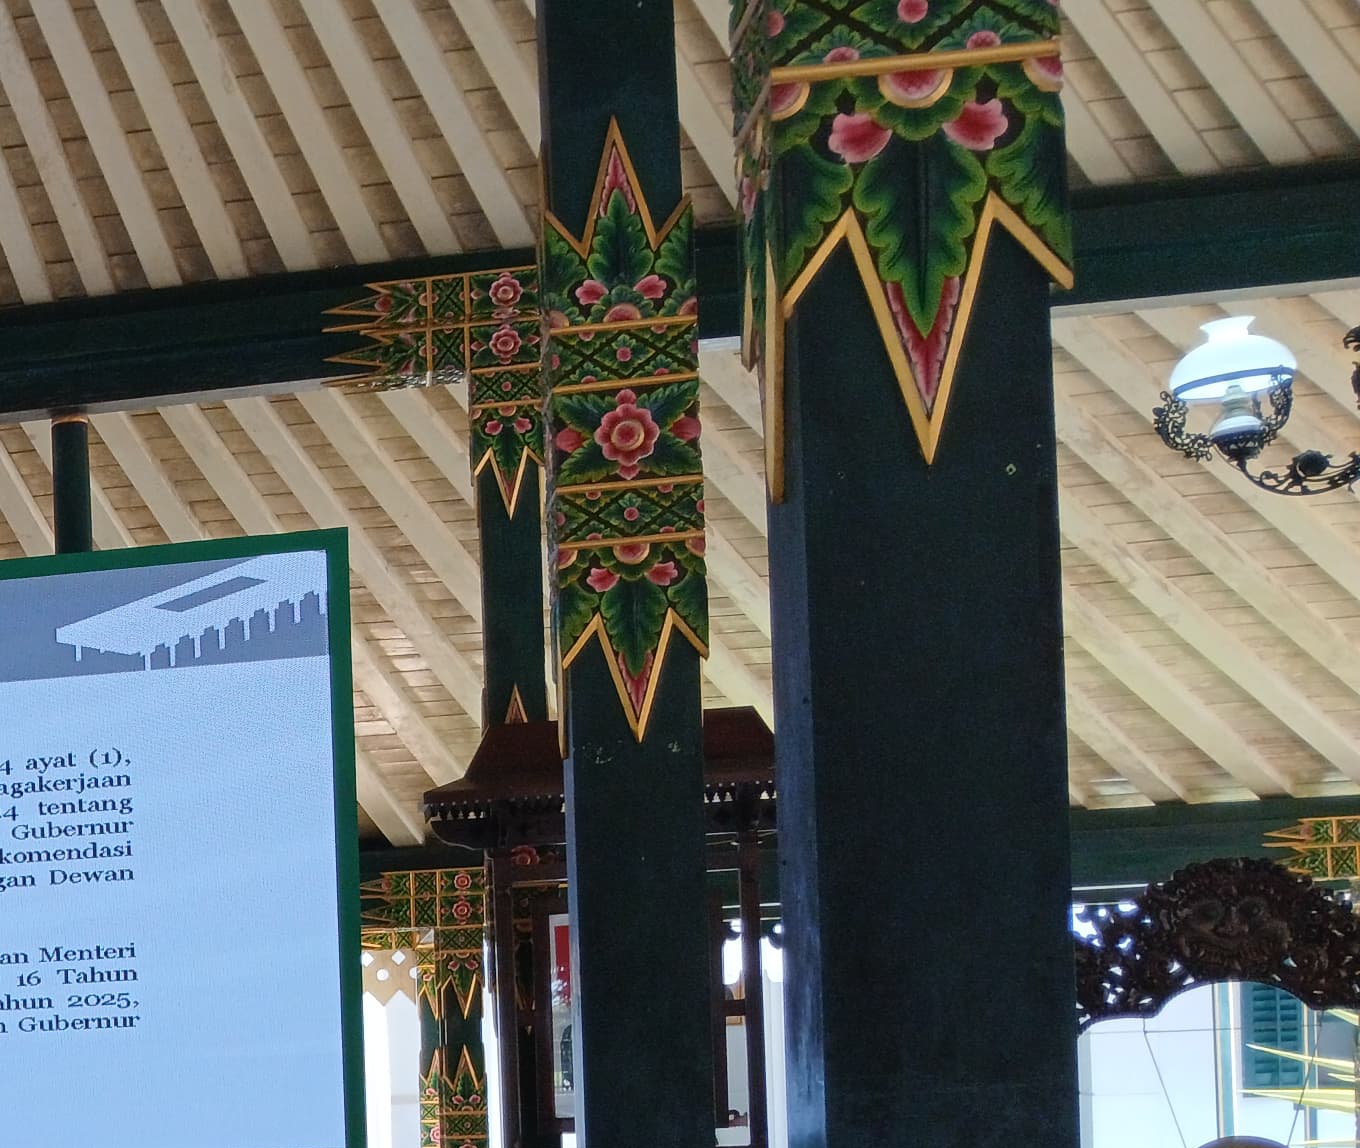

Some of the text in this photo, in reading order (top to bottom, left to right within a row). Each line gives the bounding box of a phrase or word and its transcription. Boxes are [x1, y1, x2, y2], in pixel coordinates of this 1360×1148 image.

[25, 752, 77, 773] ayat
[89, 747, 131, 769] (1),
[38, 797, 134, 816] tentang
[11, 821, 134, 840] Gubernur
[49, 868, 135, 886] Dewan
[38, 942, 136, 963] Menteri
[16, 970, 41, 987] 16
[56, 966, 139, 985] Tahun
[67, 992, 140, 1009] 2025,
[18, 1014, 141, 1032] Gubernur
